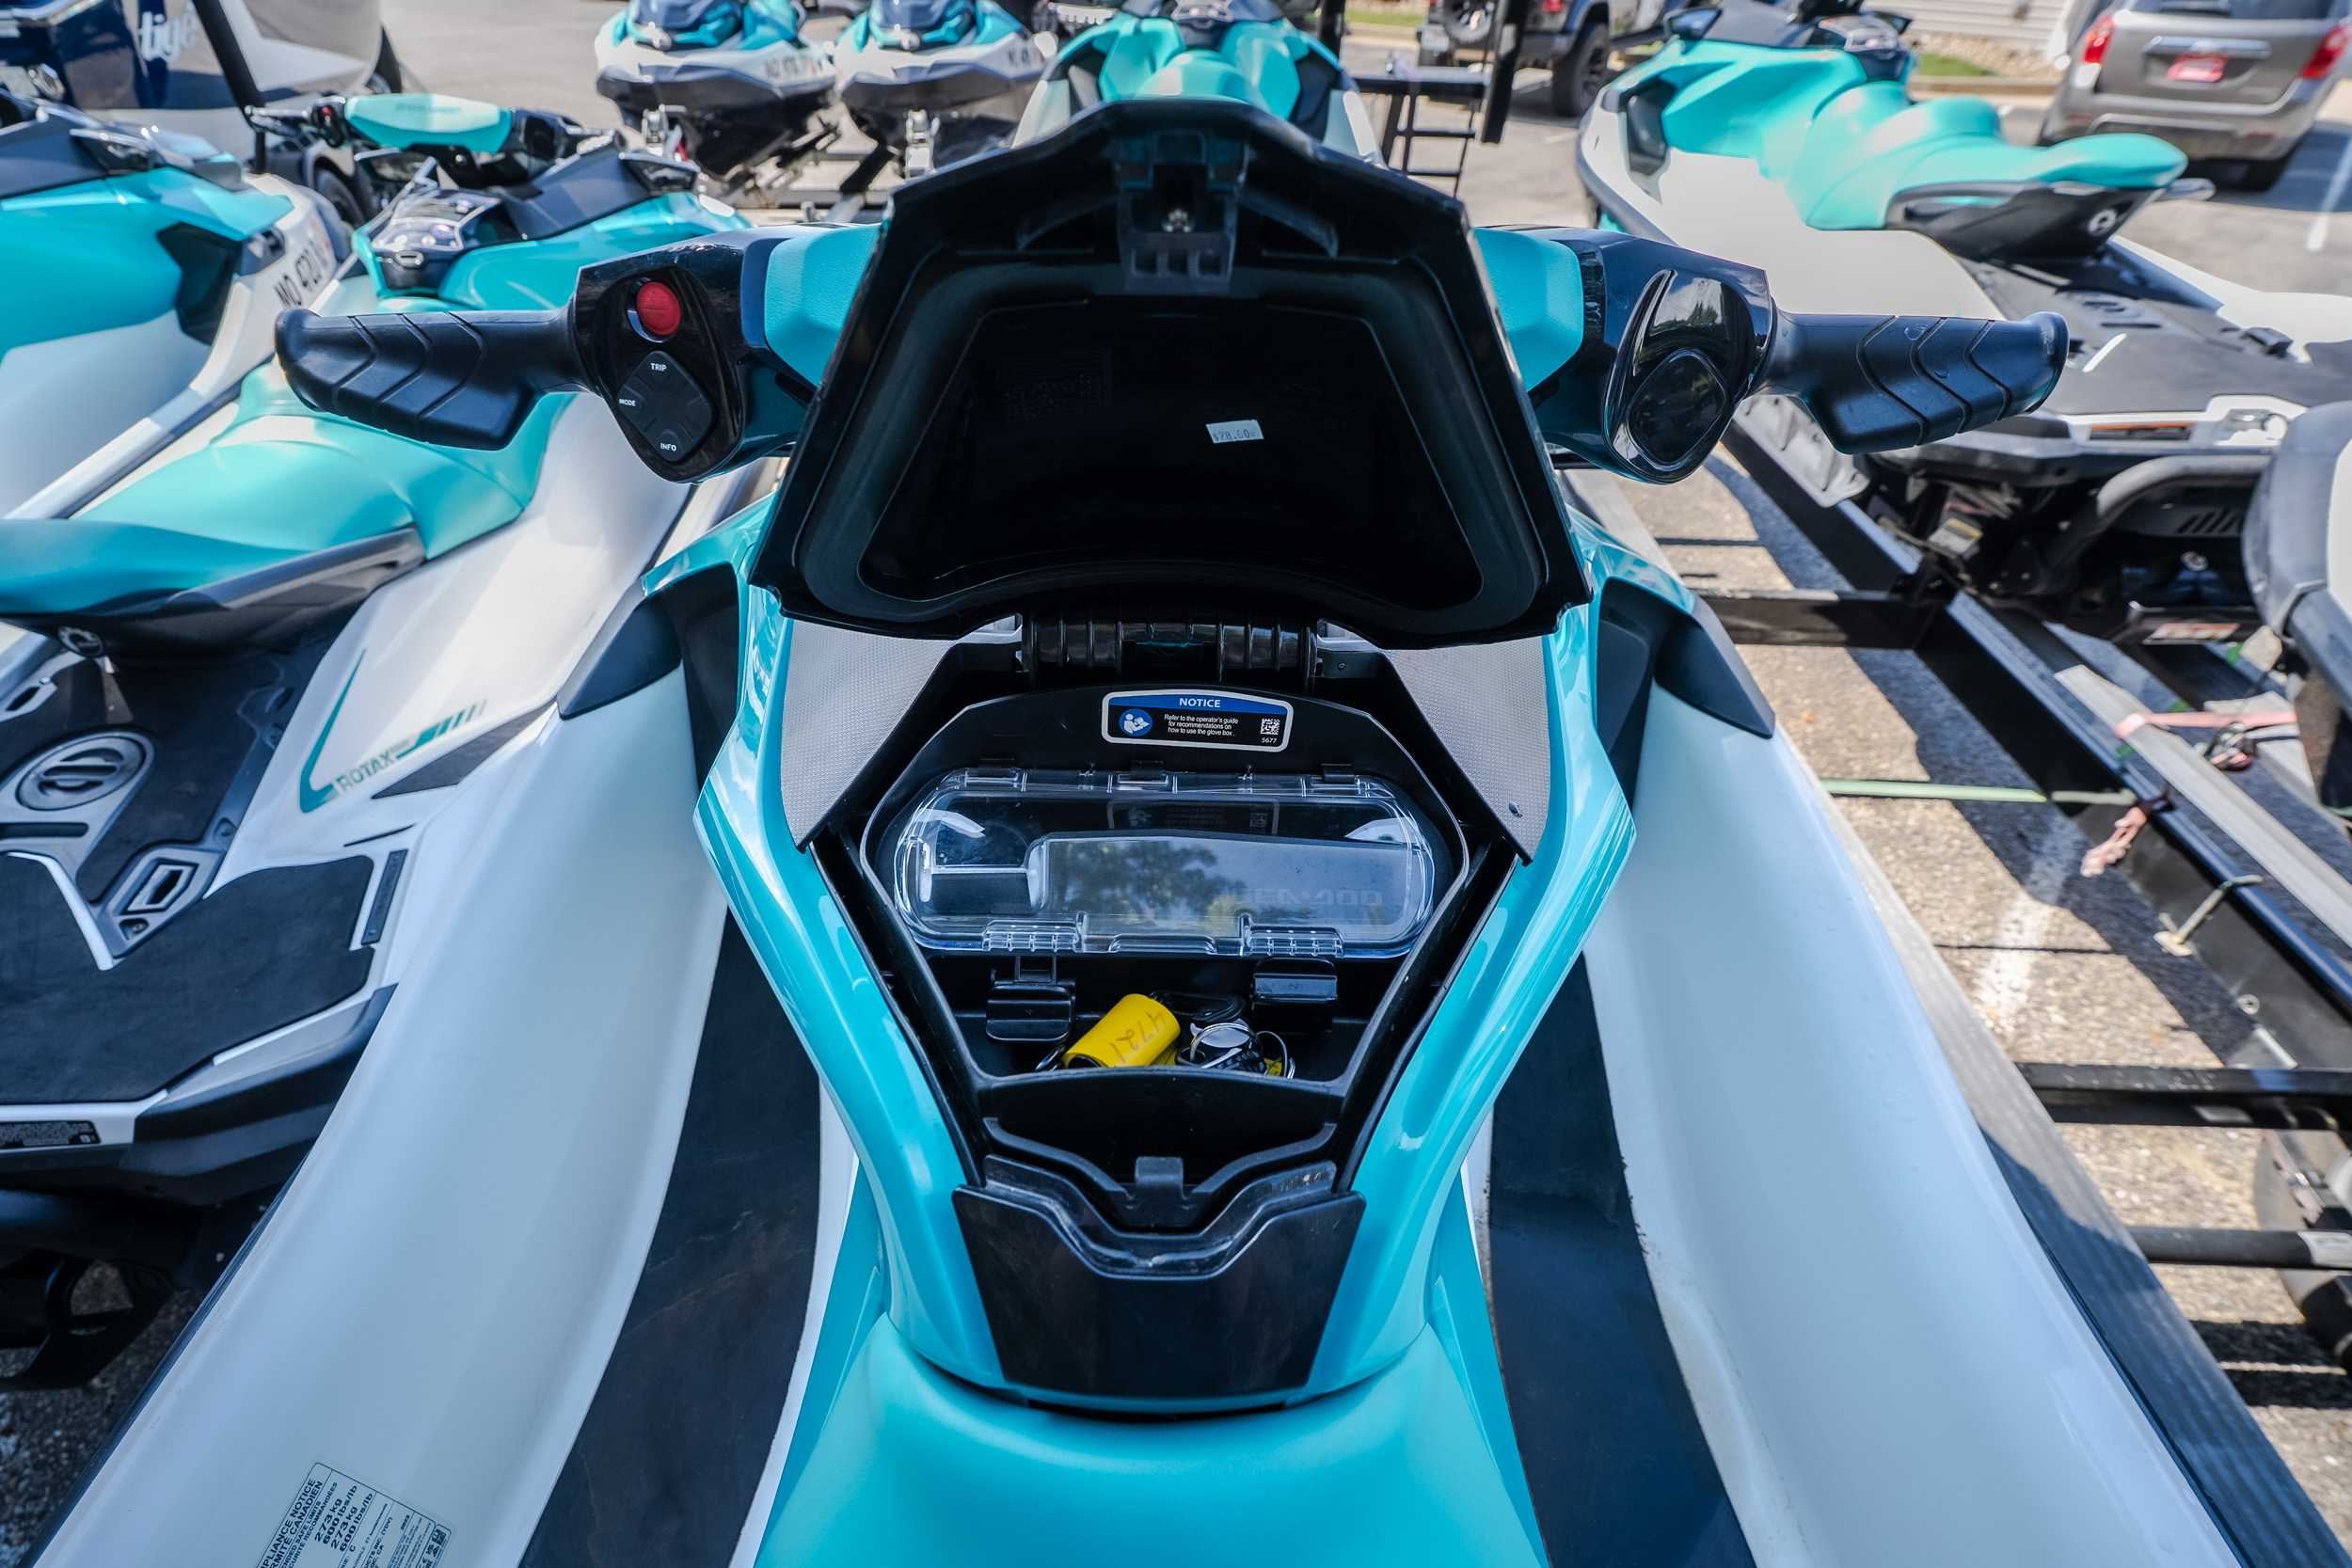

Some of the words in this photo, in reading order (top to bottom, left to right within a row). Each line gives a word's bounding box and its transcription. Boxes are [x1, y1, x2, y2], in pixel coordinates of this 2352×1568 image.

[650, 362, 667, 372] TRIP
[618, 398, 636, 407] MODE
[660, 442, 677, 451] INFO
[1179, 697, 1221, 708] NOTICE
[1176, 721, 1224, 729] recommendations
[336, 750, 395, 791] ROTAX
[1109, 1010, 1168, 1064] 4721
[290, 1479, 316, 1518] NOTICE
[290, 1481, 323, 1535] CANADIEN
[302, 1482, 338, 1541] RECOMMANDÉES
[323, 1517, 340, 1544] 600
[337, 1485, 358, 1517] lbs/lb
[294, 1525, 309, 1544] SAFE
[305, 1501, 321, 1524] LIMITS
[314, 1513, 333, 1542] 273
[329, 1498, 342, 1513] kg
[330, 1521, 348, 1549] 273
[345, 1506, 358, 1521] kg
[340, 1525, 357, 1552] 600
[353, 1493, 373, 1524] lbs/lb
[400, 1514, 410, 1530] 2023
[374, 1545, 384, 1555] CA
